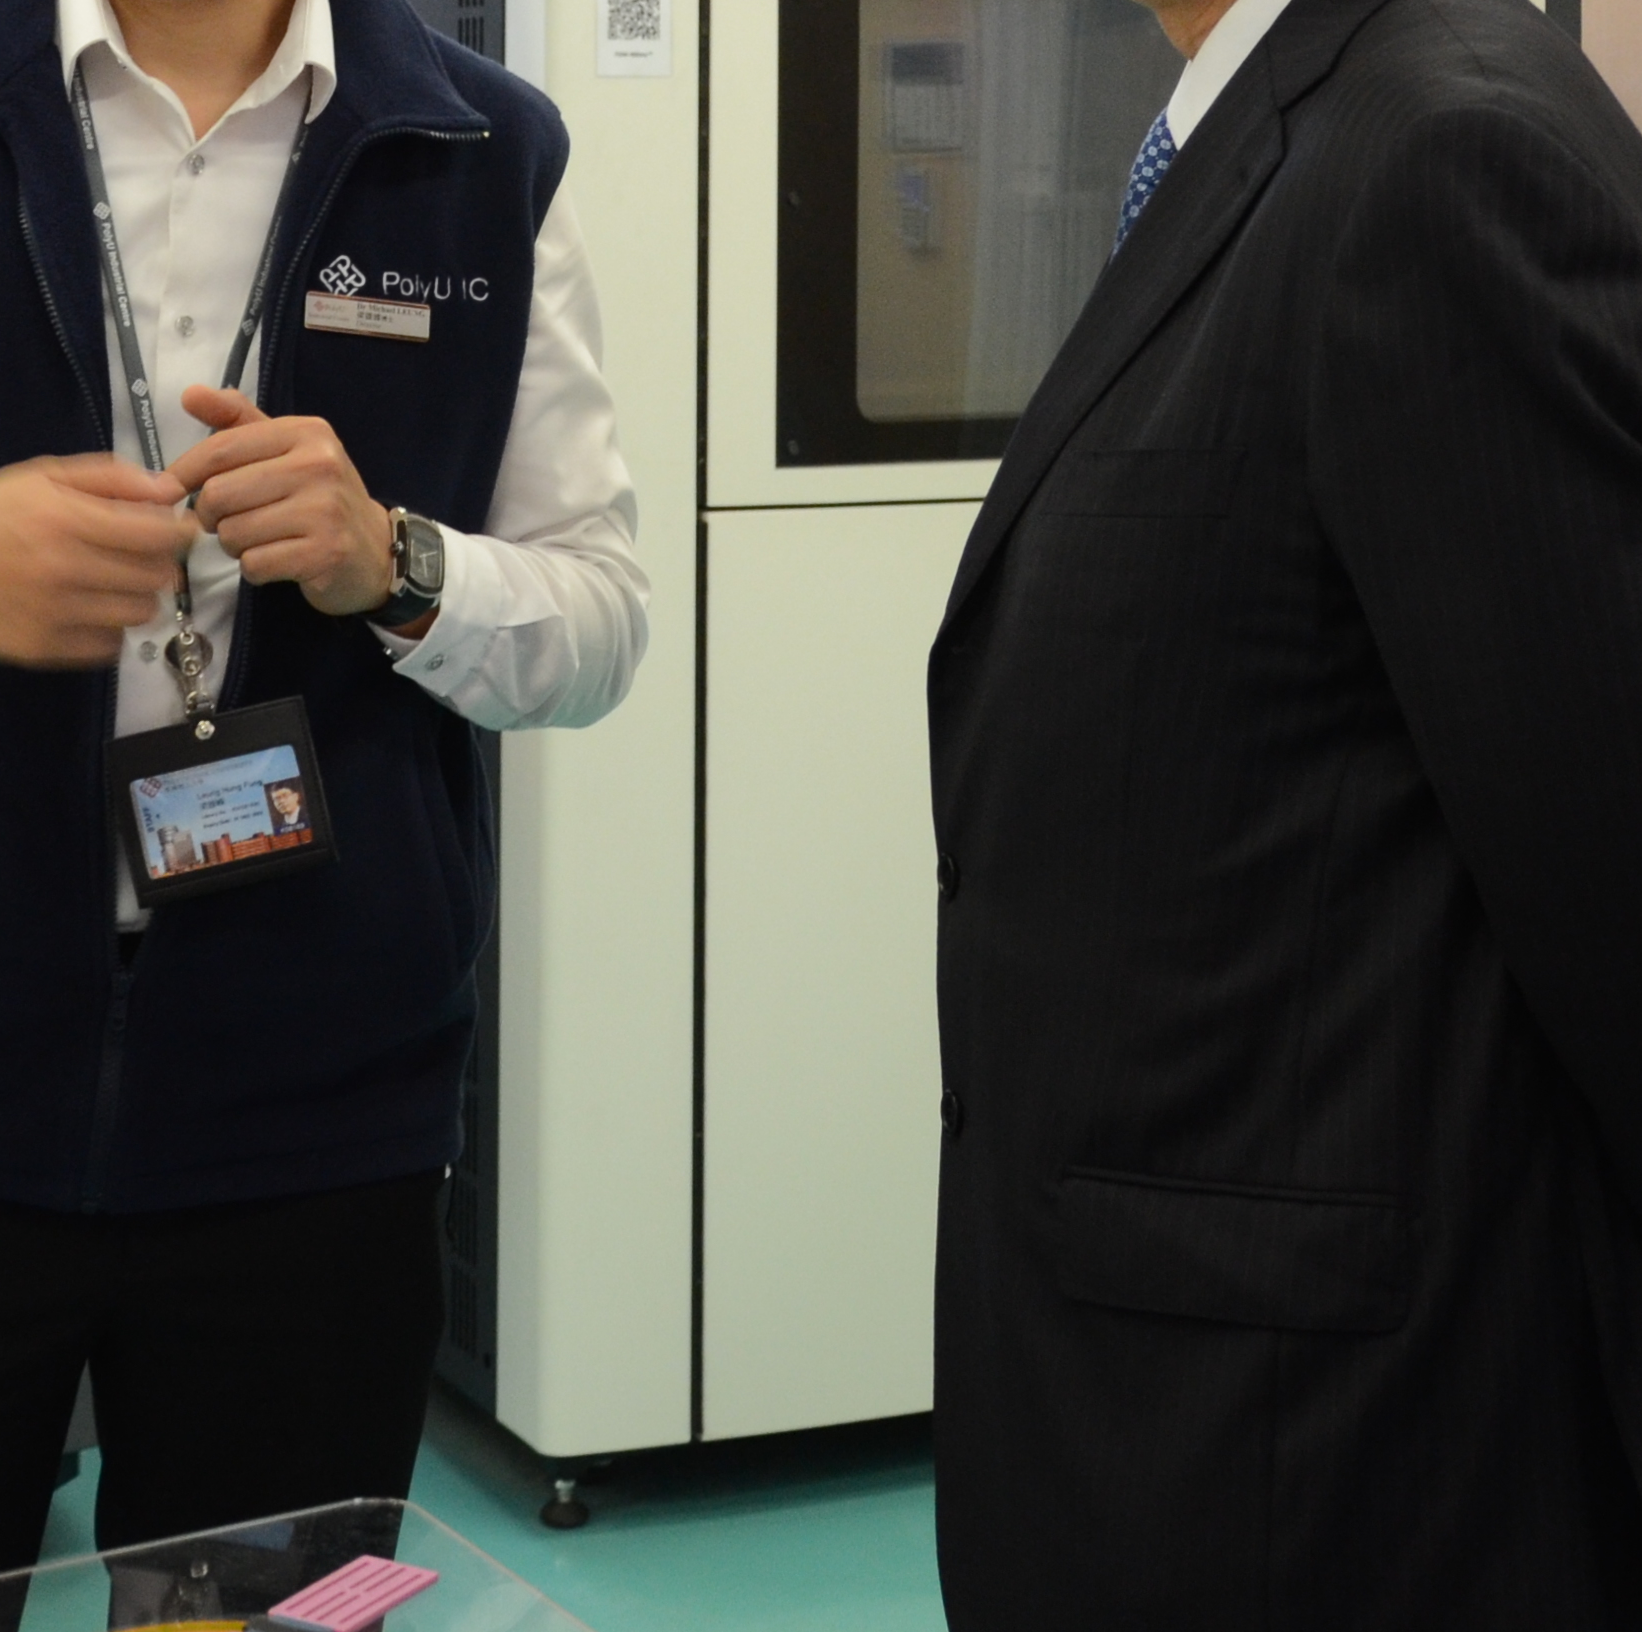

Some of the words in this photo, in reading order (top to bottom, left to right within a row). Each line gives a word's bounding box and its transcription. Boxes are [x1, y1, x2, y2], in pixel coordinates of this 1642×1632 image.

[81, 119, 95, 150] Centre
[101, 222, 116, 250] PolyU
[107, 250, 126, 295] Industrial
[382, 271, 452, 303] PolyU
[462, 277, 490, 302] IC
[117, 295, 131, 327] Centre
[140, 399, 154, 428] PolyU
